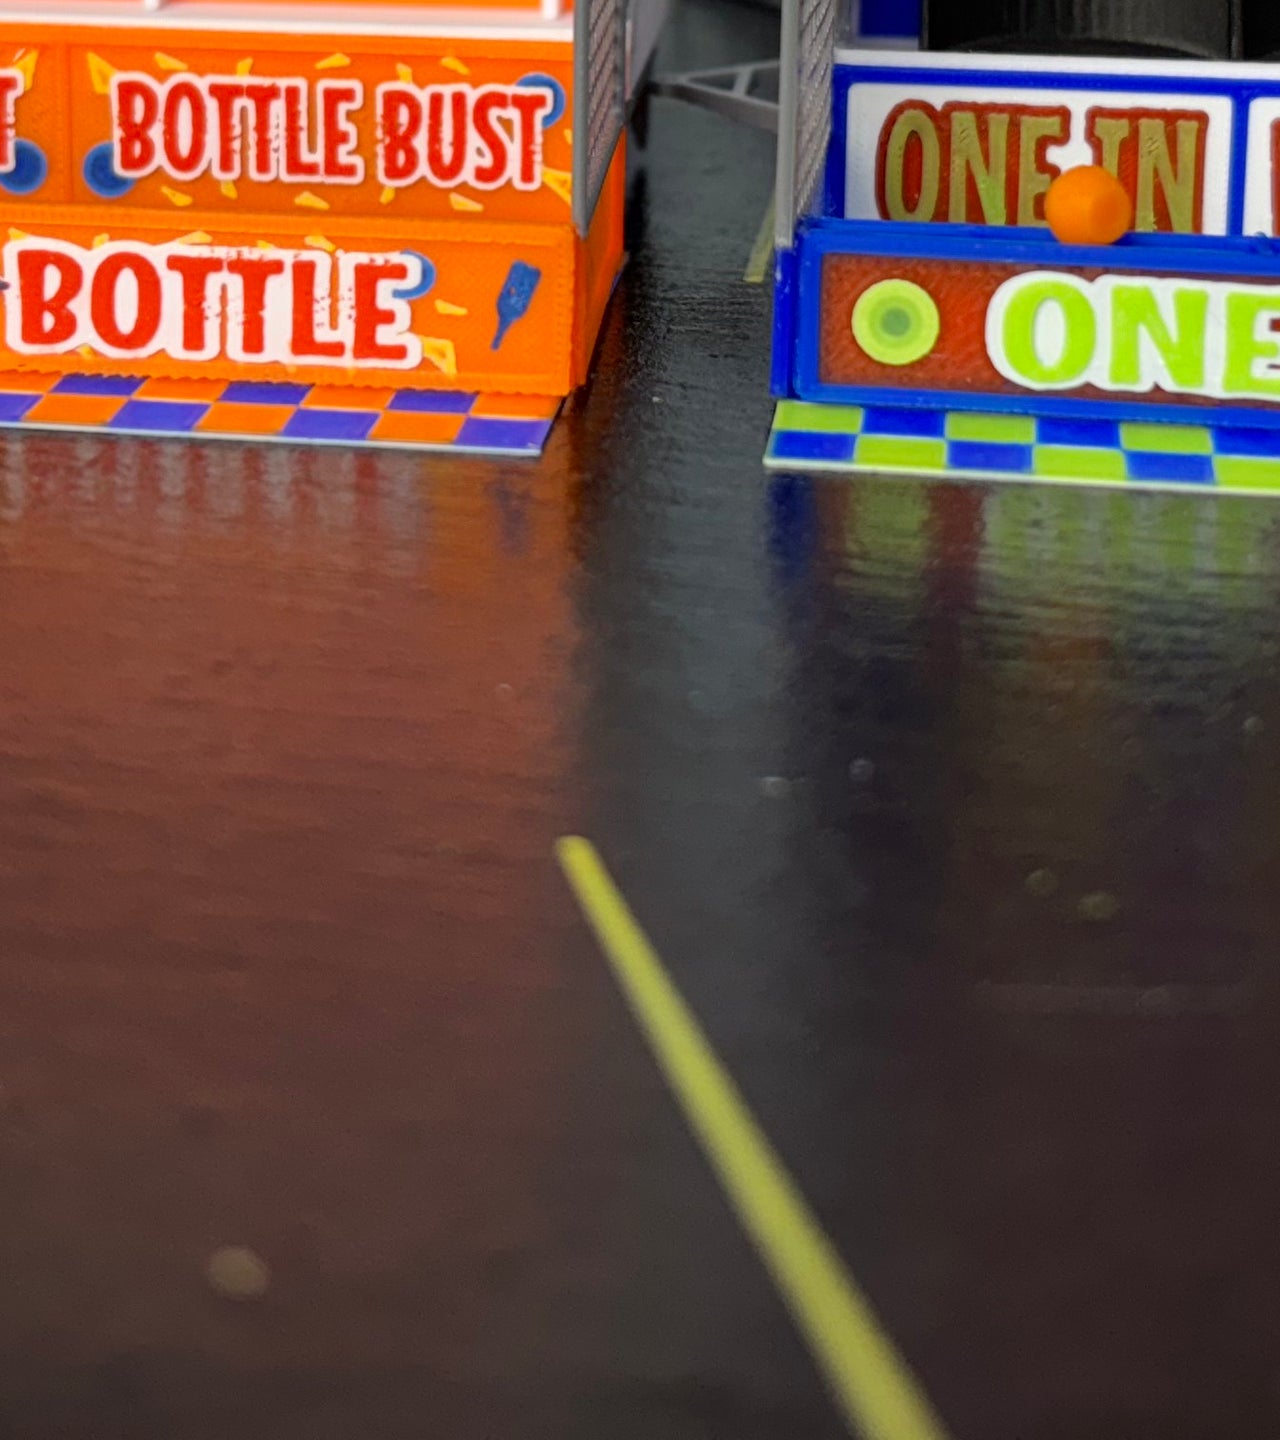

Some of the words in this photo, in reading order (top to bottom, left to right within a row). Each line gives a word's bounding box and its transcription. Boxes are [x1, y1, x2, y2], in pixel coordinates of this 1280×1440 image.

[114, 77, 361, 182] BOTTLE
[378, 85, 550, 189] BUST
[879, 104, 1066, 232] ONE
[14, 245, 412, 364] BOTTLE
